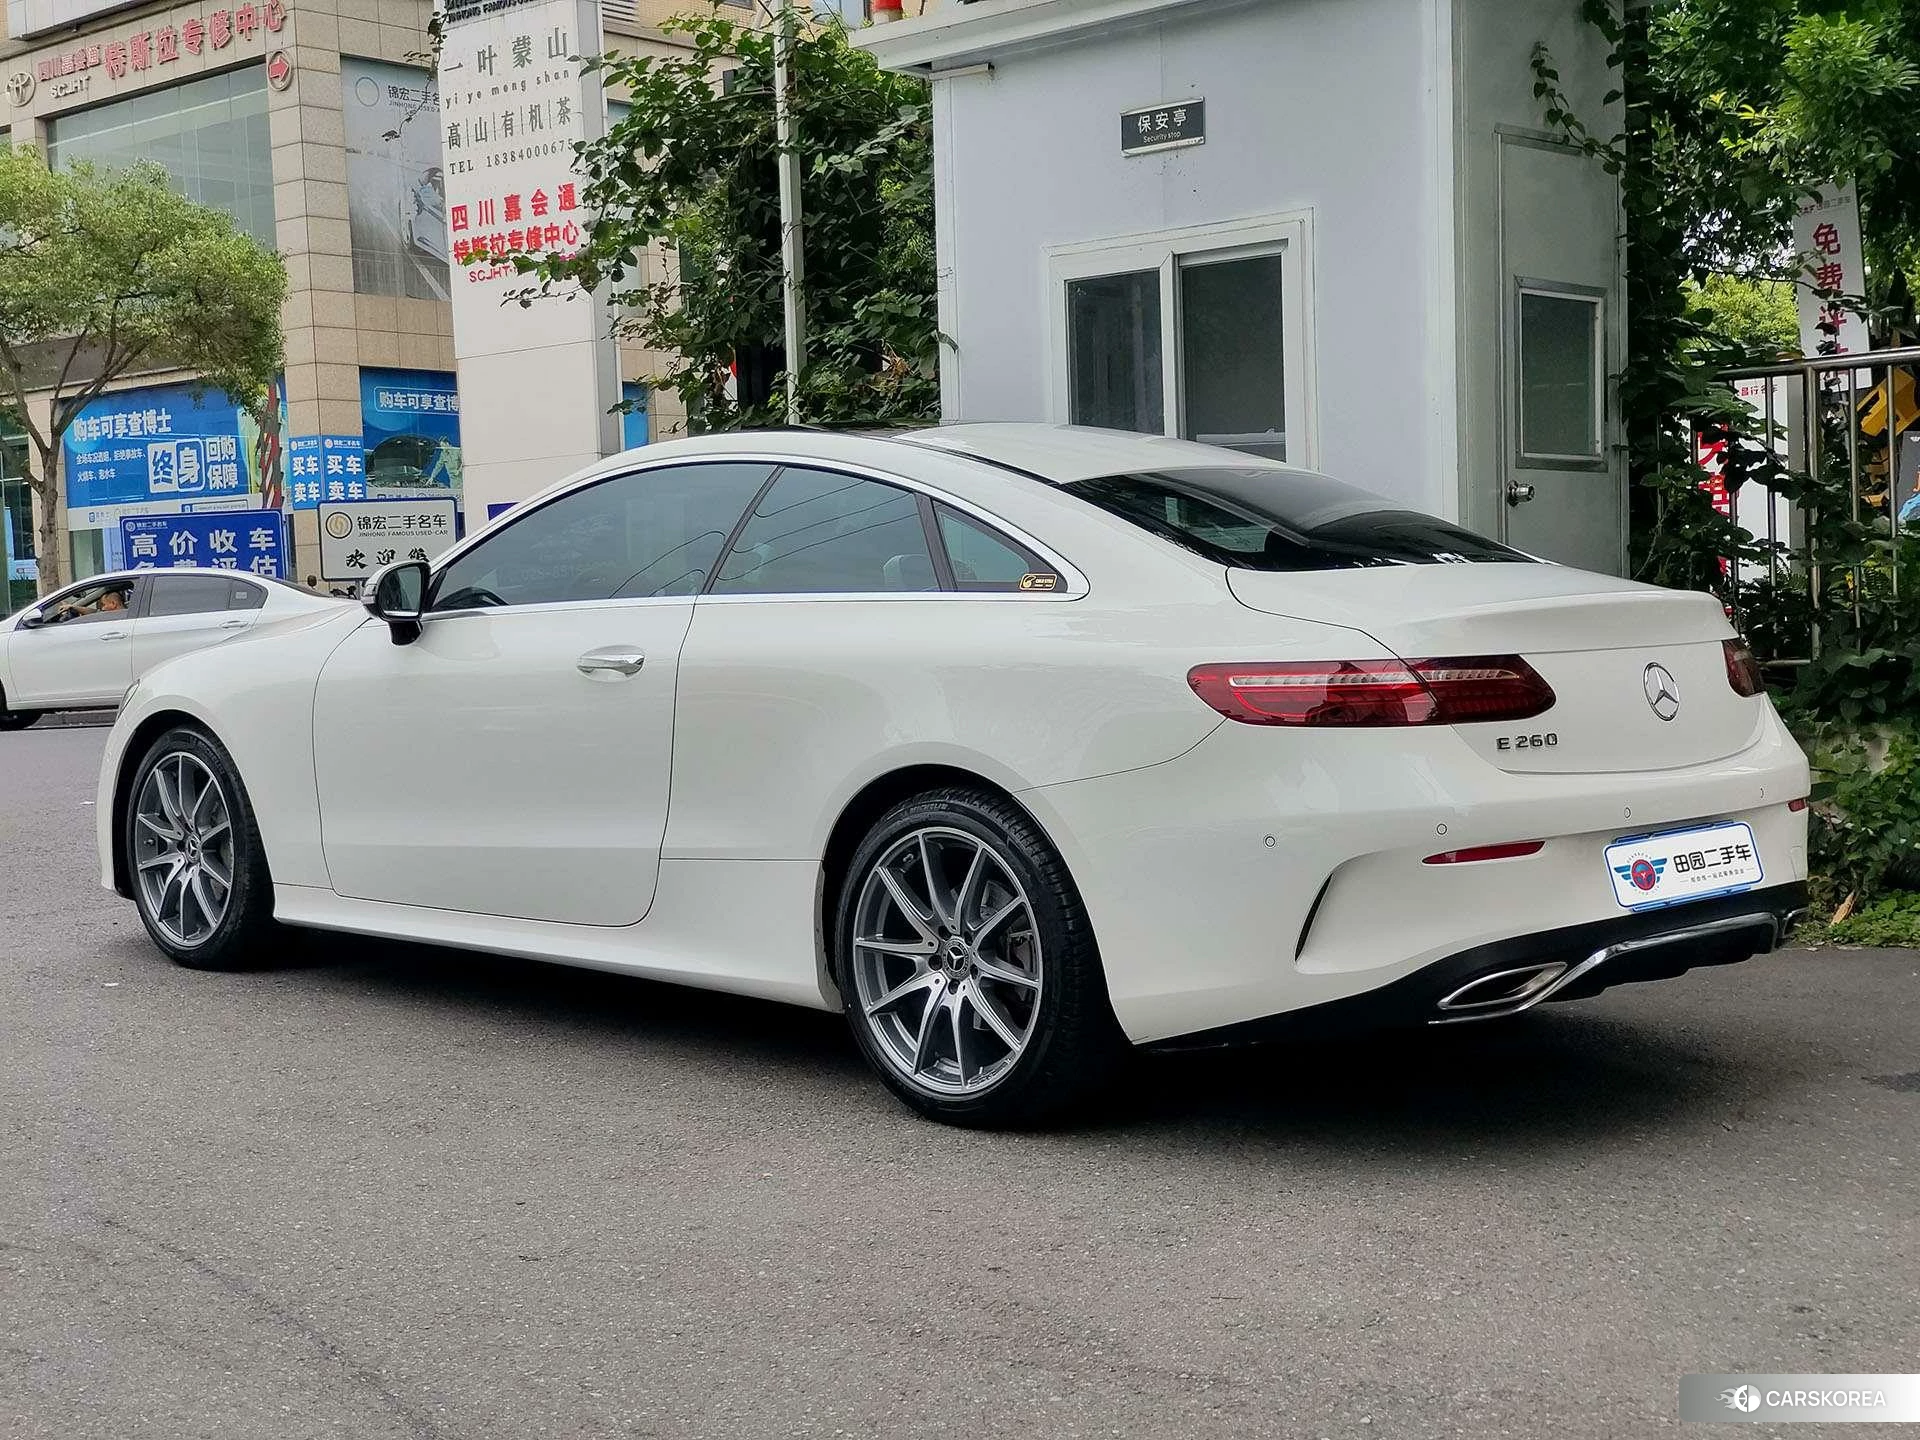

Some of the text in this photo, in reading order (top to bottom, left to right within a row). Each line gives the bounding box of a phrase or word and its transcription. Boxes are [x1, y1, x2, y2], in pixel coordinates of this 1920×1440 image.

[444, 27, 568, 76] 一叶蒙山
[536, 69, 569, 85] shan
[1138, 108, 1187, 134] 保安亭
[449, 138, 573, 175] TEL 18384000675
[74, 408, 172, 442] 购车可享查博士
[292, 454, 319, 477] 买车
[327, 454, 363, 475] 买车
[294, 481, 321, 503] 卖车
[328, 480, 365, 500] 卖车
[357, 513, 447, 531] 锦宏二手名车
[130, 527, 277, 559] 高价收车
[1496, 732, 1558, 750] E 260
[1673, 843, 1753, 874] 田园二手车
